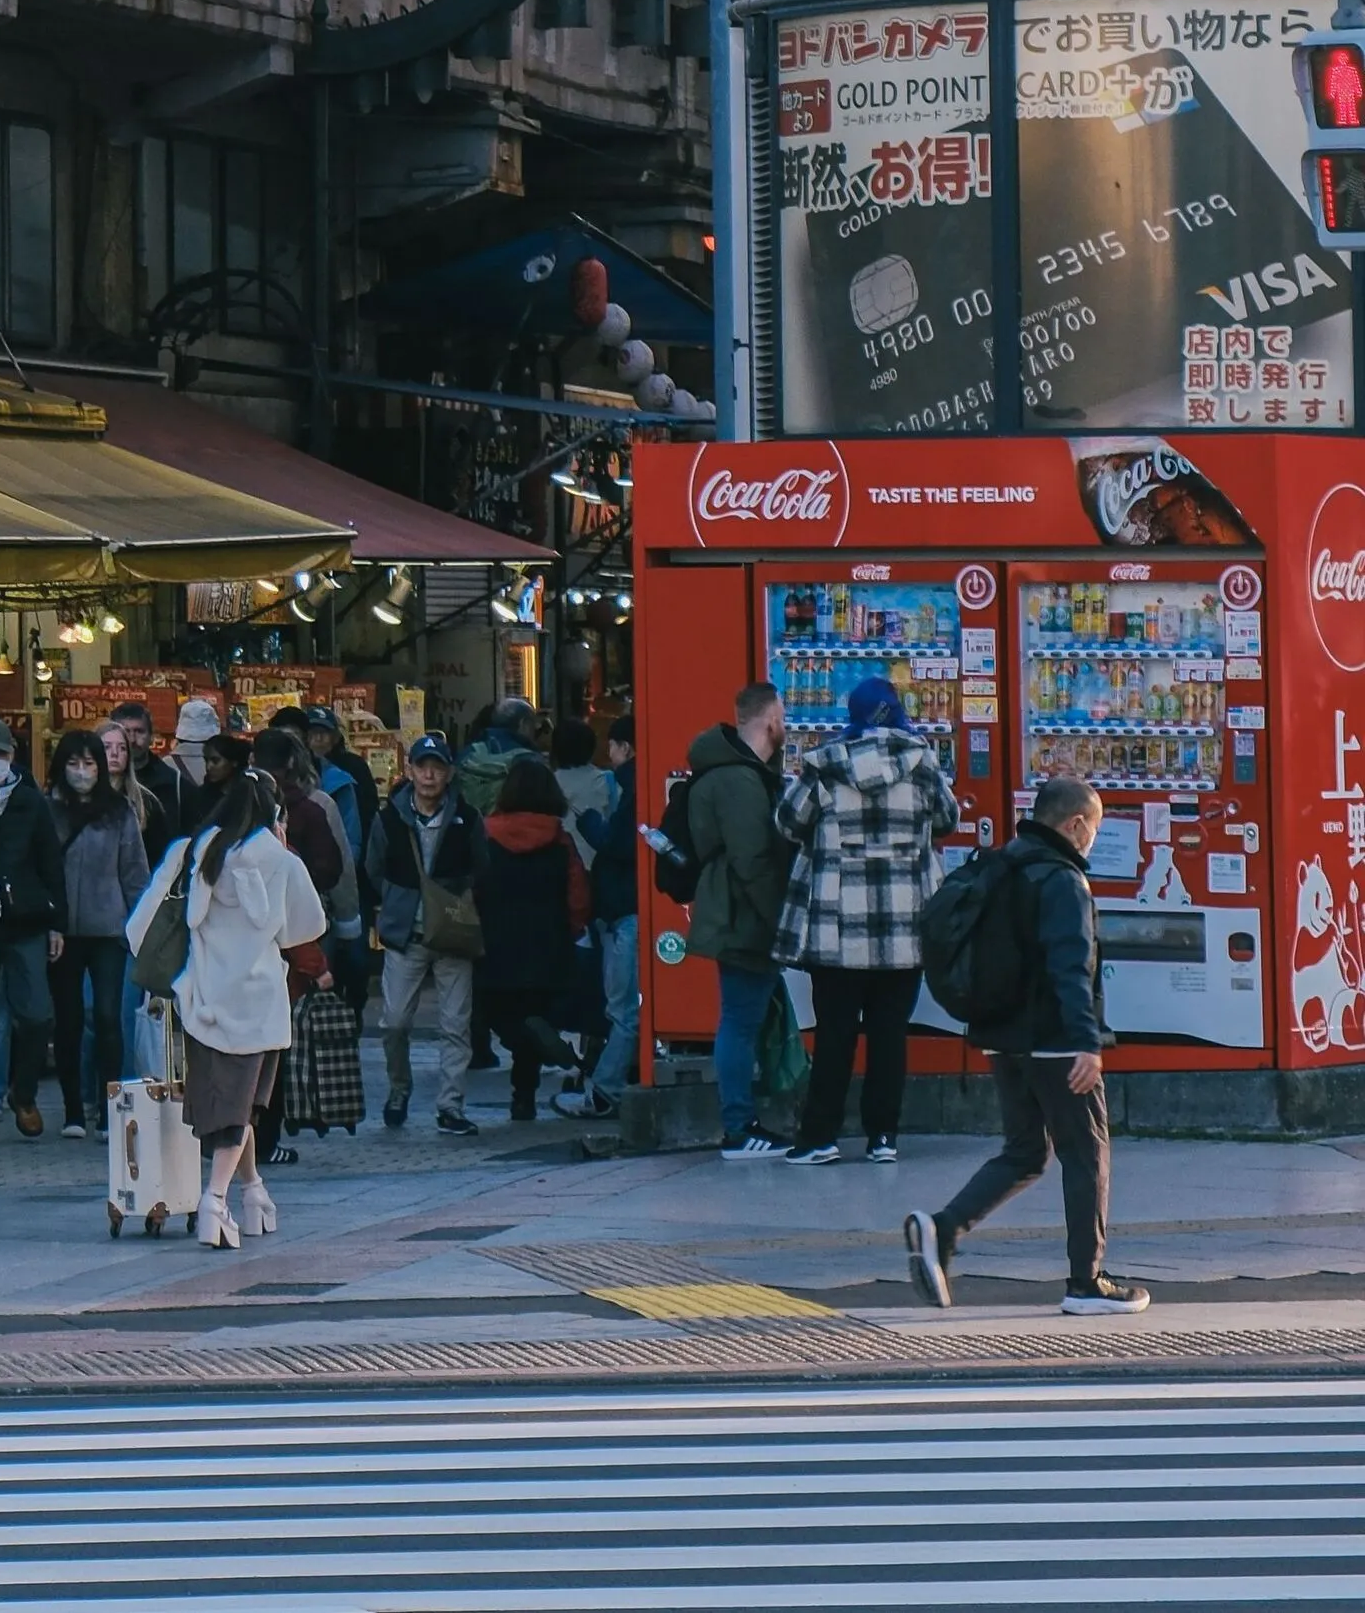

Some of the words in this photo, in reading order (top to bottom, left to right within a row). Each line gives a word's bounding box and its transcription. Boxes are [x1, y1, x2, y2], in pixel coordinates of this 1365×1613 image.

[778, 12, 990, 73] ヨドバシカメラ
[1014, 7, 1316, 54] でお買い物なら
[781, 89, 826, 112] 他カード
[837, 80, 898, 110] GOLD
[905, 74, 988, 106] POINT
[792, 111, 814, 132] より
[862, 313, 936, 368] 4980
[1037, 230, 1127, 285] 2345
[1142, 193, 1239, 244] 6789
[1194, 252, 1339, 321] VISA
[1185, 327, 1292, 358] 店内で
[1020, 341, 1077, 383] ARO
[1185, 362, 1329, 390] 即時発行
[869, 367, 899, 392] 4980
[1185, 397, 1347, 424] 致します!
[698, 467, 840, 523] Coca-Cola
[869, 488, 921, 505] TASTE
[924, 487, 958, 504] THE
[961, 486, 1036, 504] FEELING
[1323, 821, 1345, 834] UENO
